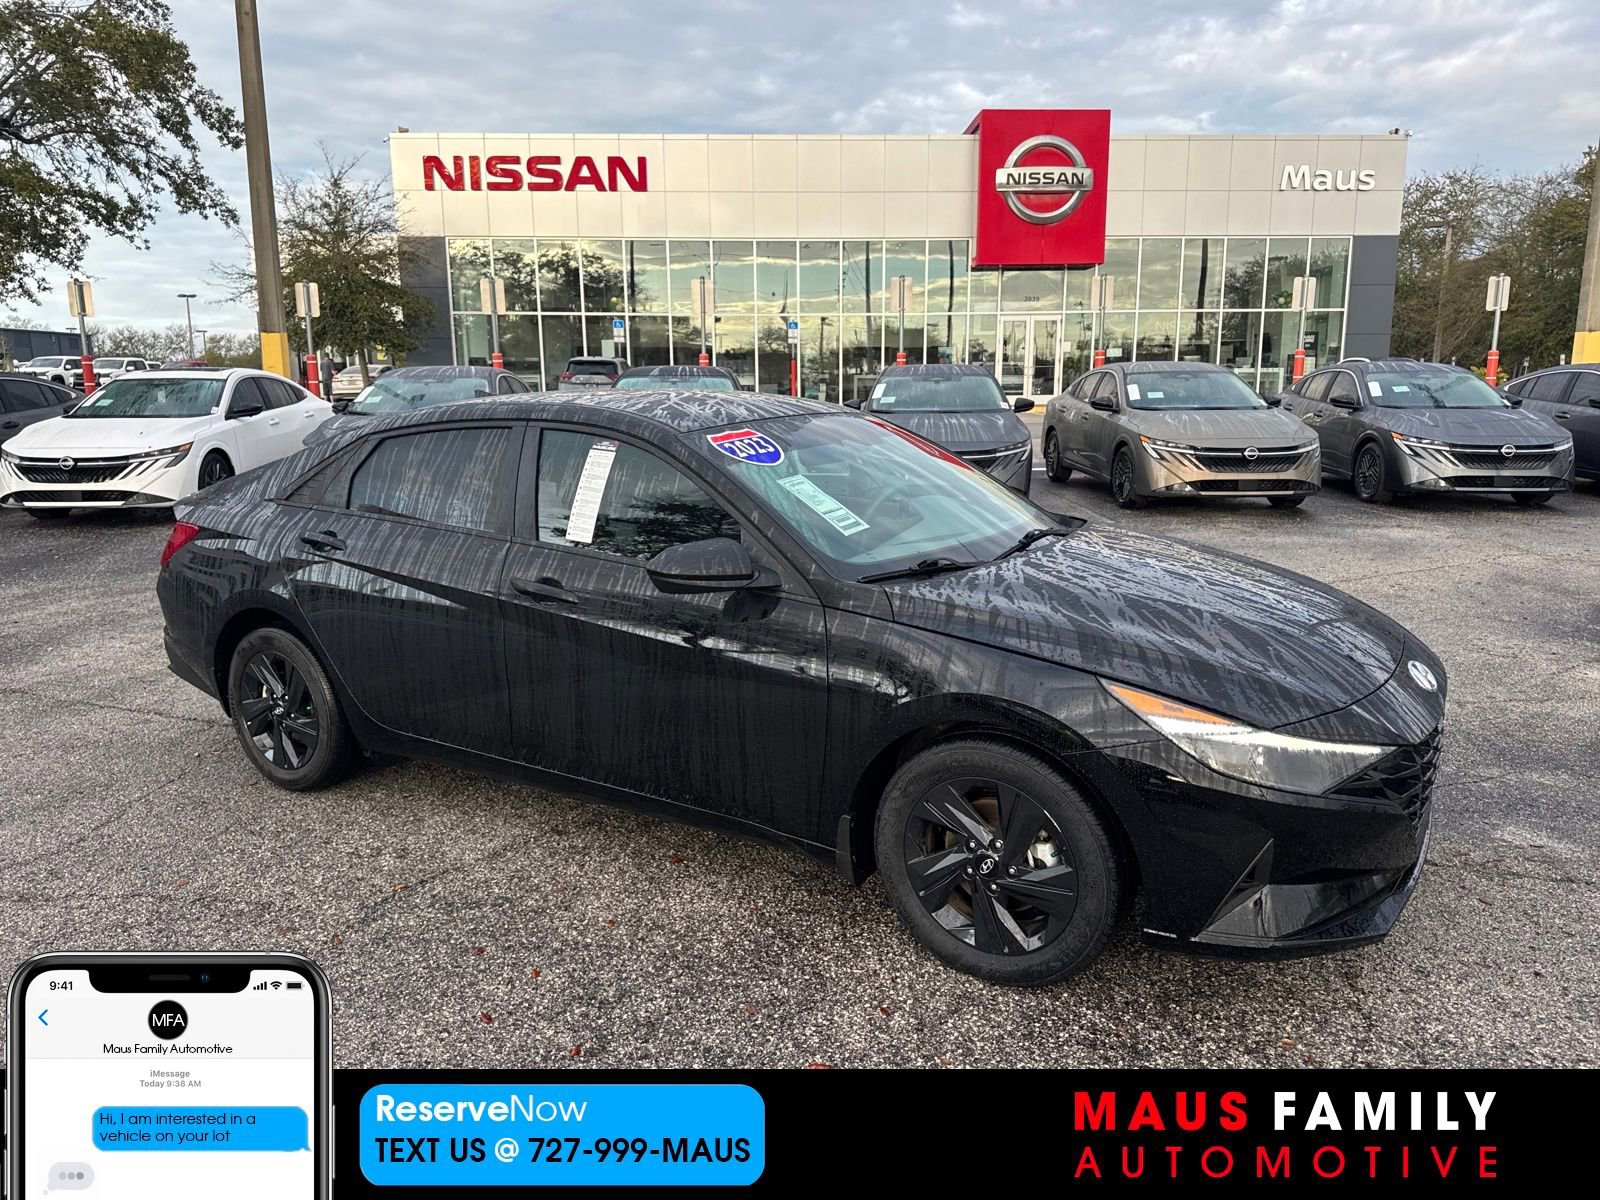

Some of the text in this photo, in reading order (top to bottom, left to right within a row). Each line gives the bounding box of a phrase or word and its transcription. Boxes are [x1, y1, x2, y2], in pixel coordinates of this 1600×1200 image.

[423, 155, 648, 192] NISSAN
[1006, 172, 1085, 186] NISSAN
[1280, 164, 1376, 191] Maus
[724, 437, 775, 458] 2023
